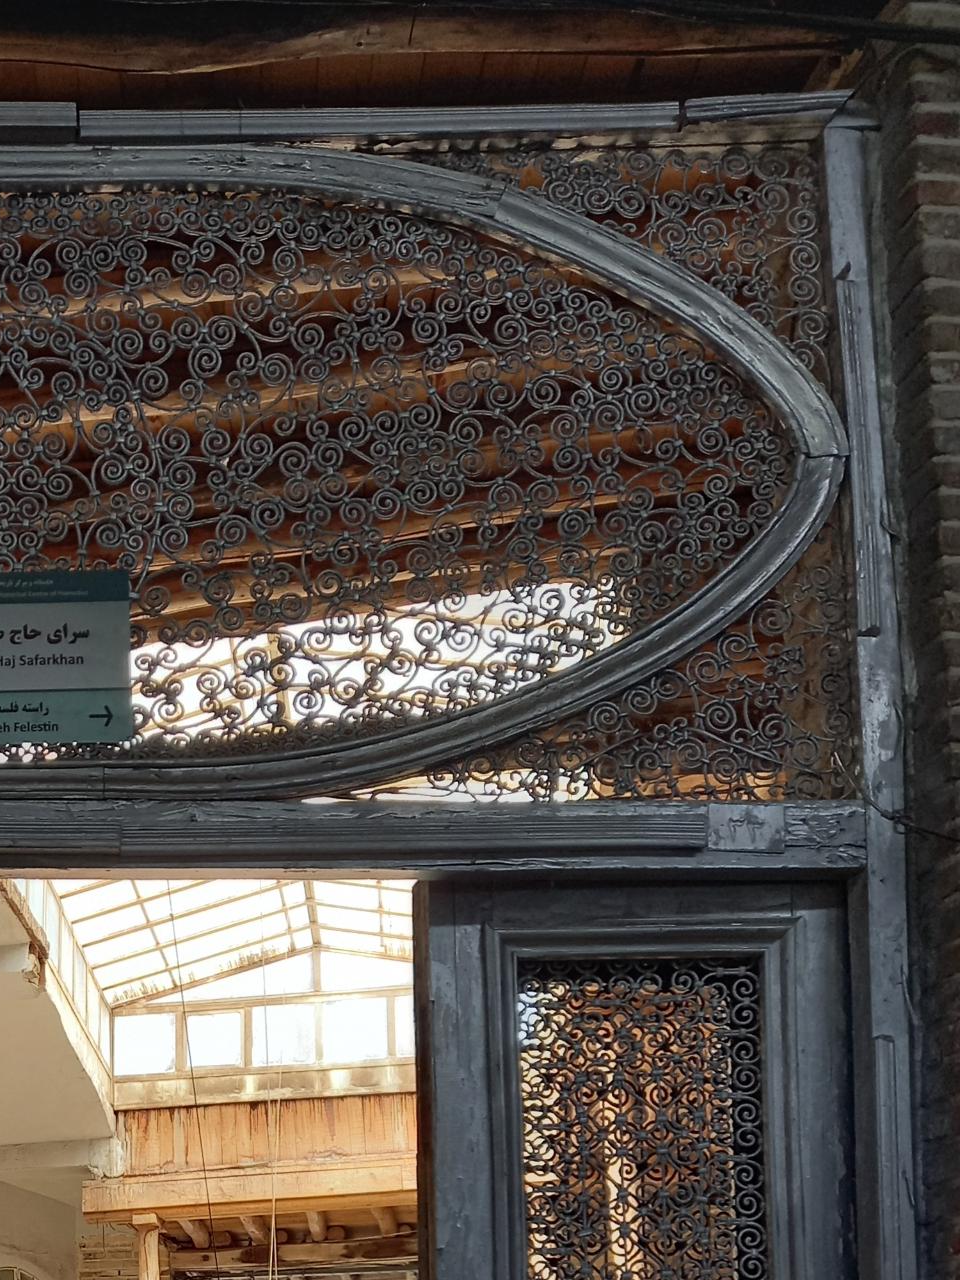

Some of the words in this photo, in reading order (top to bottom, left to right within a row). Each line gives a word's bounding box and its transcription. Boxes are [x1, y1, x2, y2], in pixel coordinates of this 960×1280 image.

[9, 623, 41, 645] حاج
[46, 622, 90, 645] سرای
[19, 653, 85, 667] Safarkhan
[22, 701, 49, 717] راسته
[14, 720, 59, 733] Felestin
